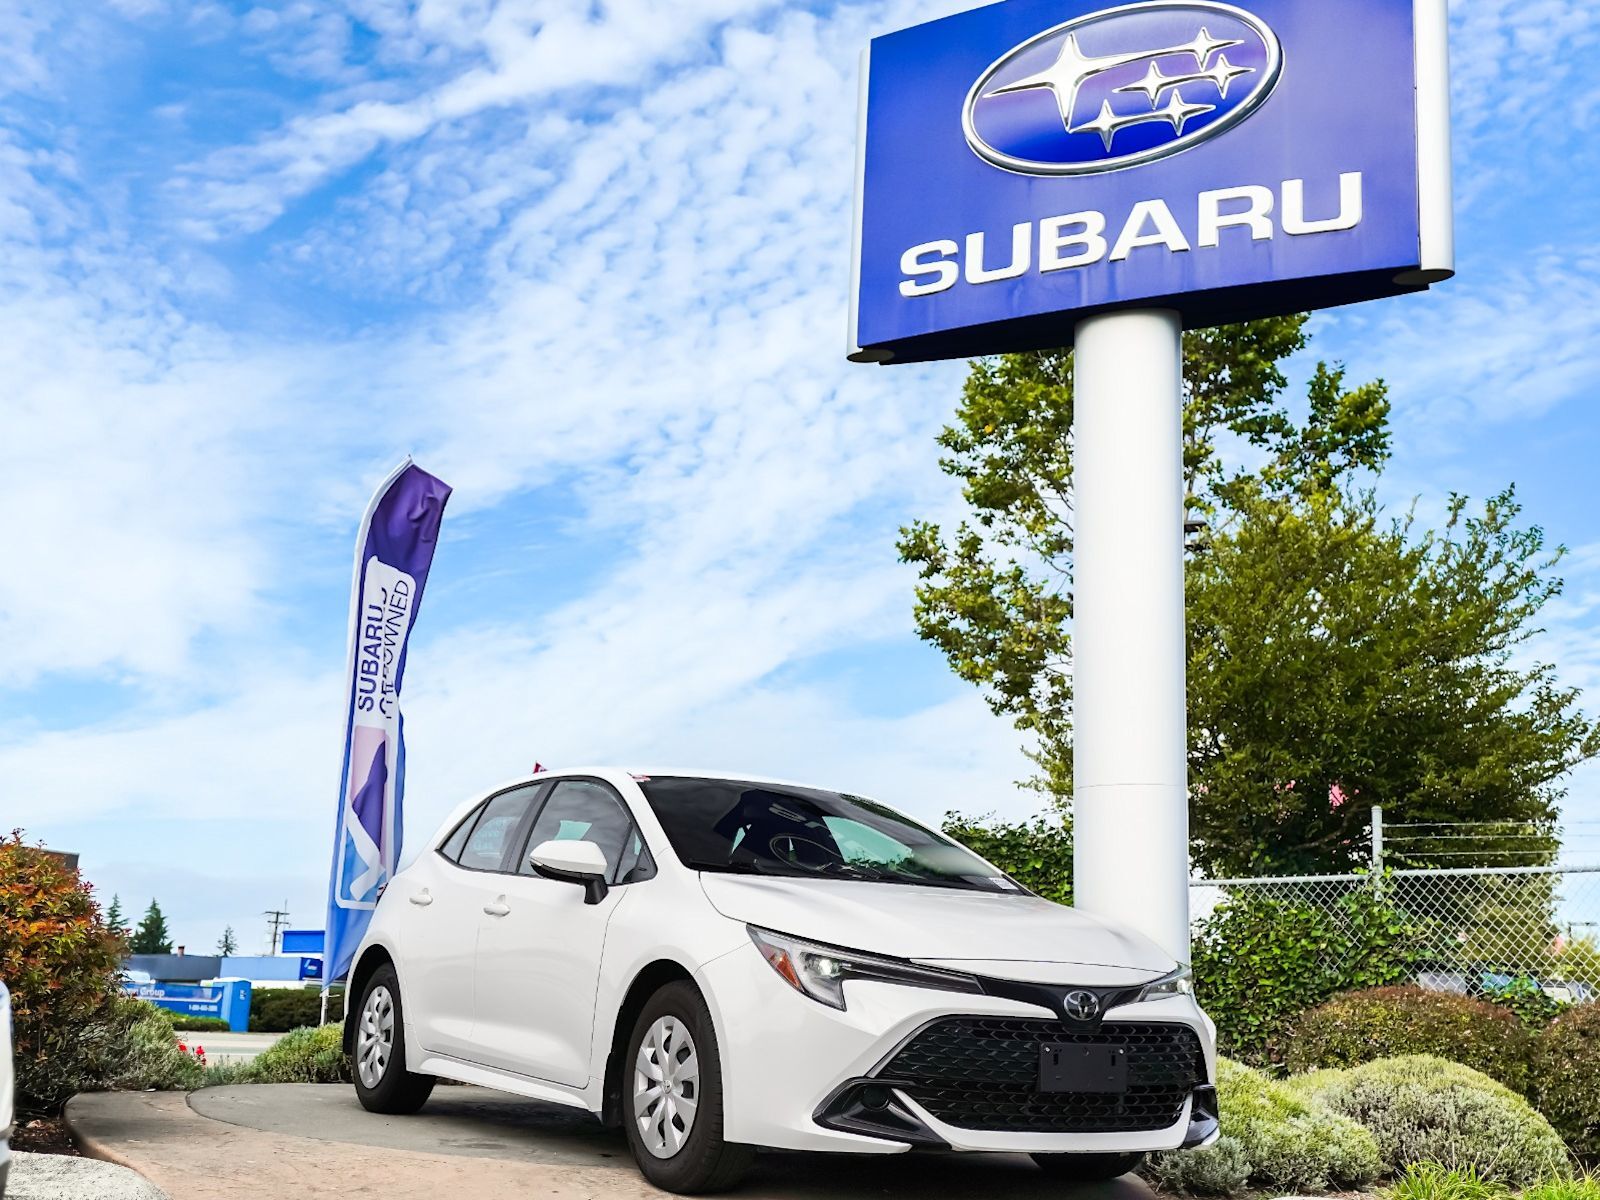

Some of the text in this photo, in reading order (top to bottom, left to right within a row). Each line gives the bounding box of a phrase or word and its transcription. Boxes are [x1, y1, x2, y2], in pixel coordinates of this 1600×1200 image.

[899, 172, 1362, 297] SUBARU
[358, 604, 383, 712] SUBARU
[140, 987, 165, 997] Group
